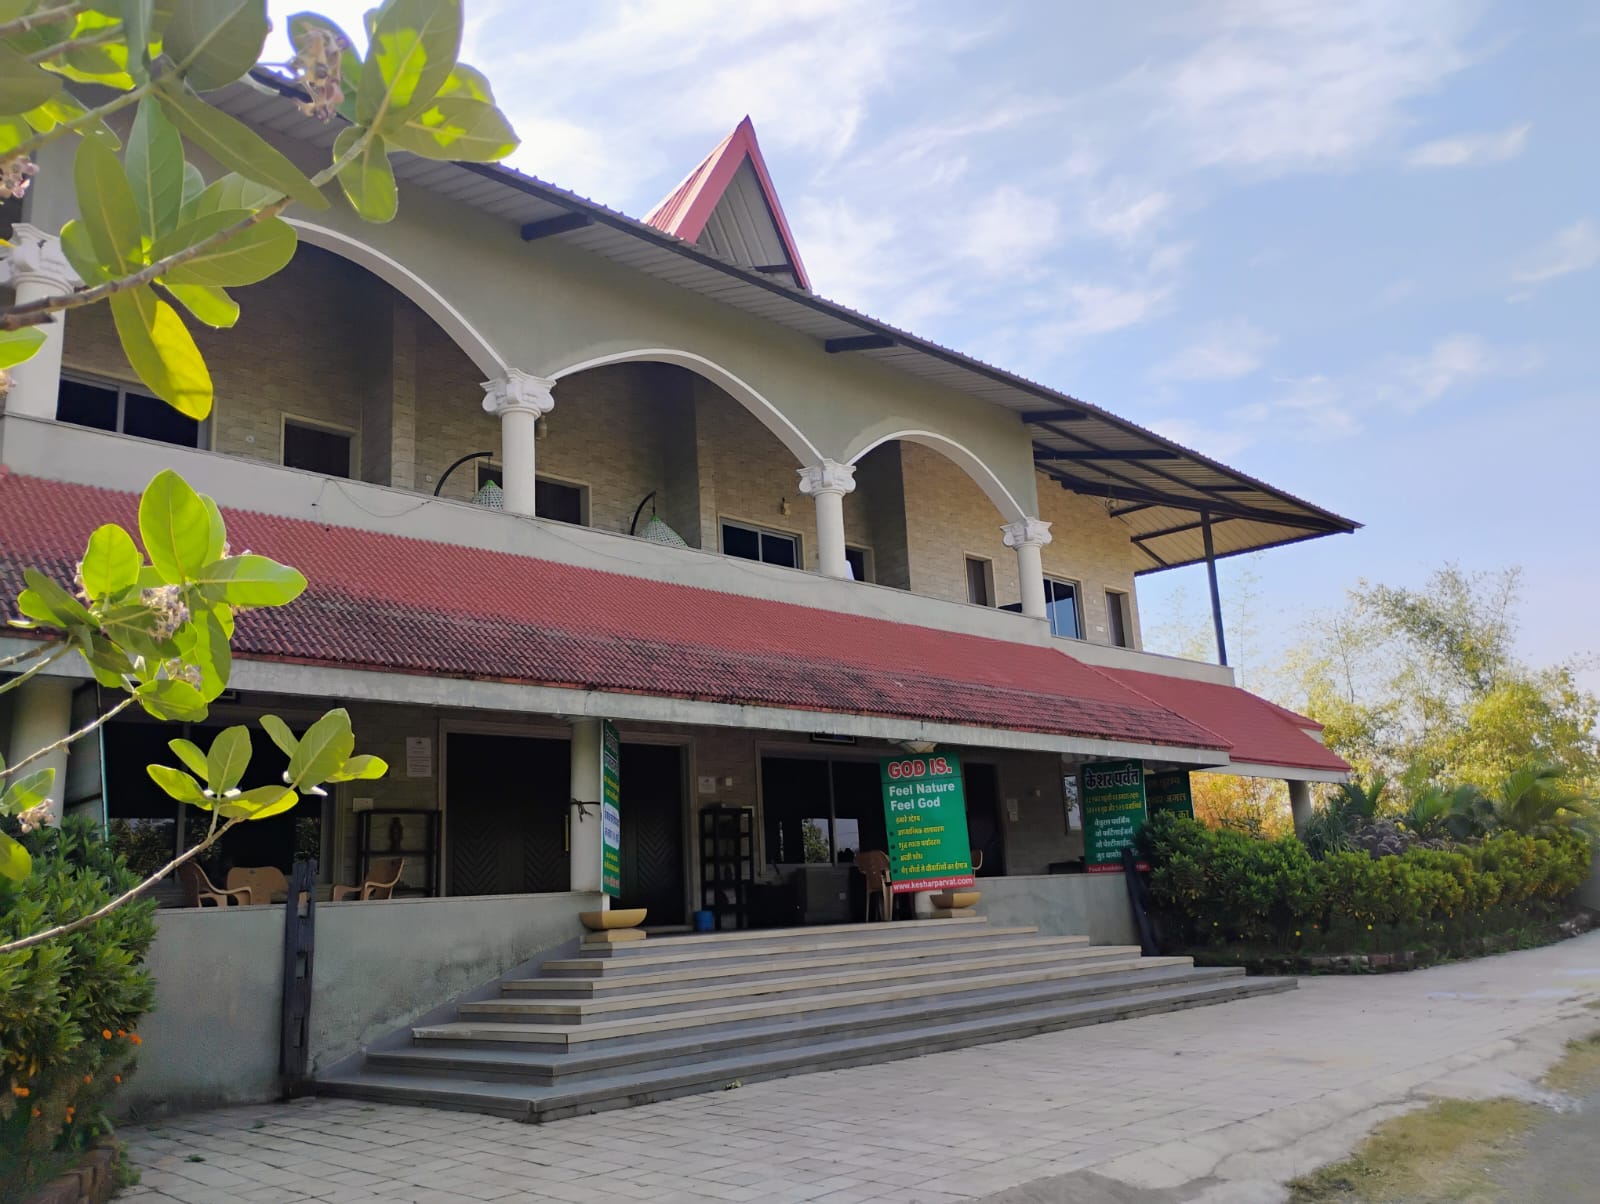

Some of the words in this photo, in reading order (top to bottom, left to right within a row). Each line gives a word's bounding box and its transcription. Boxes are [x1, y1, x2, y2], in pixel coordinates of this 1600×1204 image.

[888, 759, 926, 779] GOD
[929, 757, 952, 775] IS.
[1085, 768, 1113, 789] केशर
[1113, 763, 1139, 787] पर्वत
[889, 785, 913, 797] Feel
[916, 782, 955, 794] Nature
[891, 799, 915, 811] Feel
[918, 796, 941, 808] God
[893, 877, 973, 891] www.kesharparvat.com
